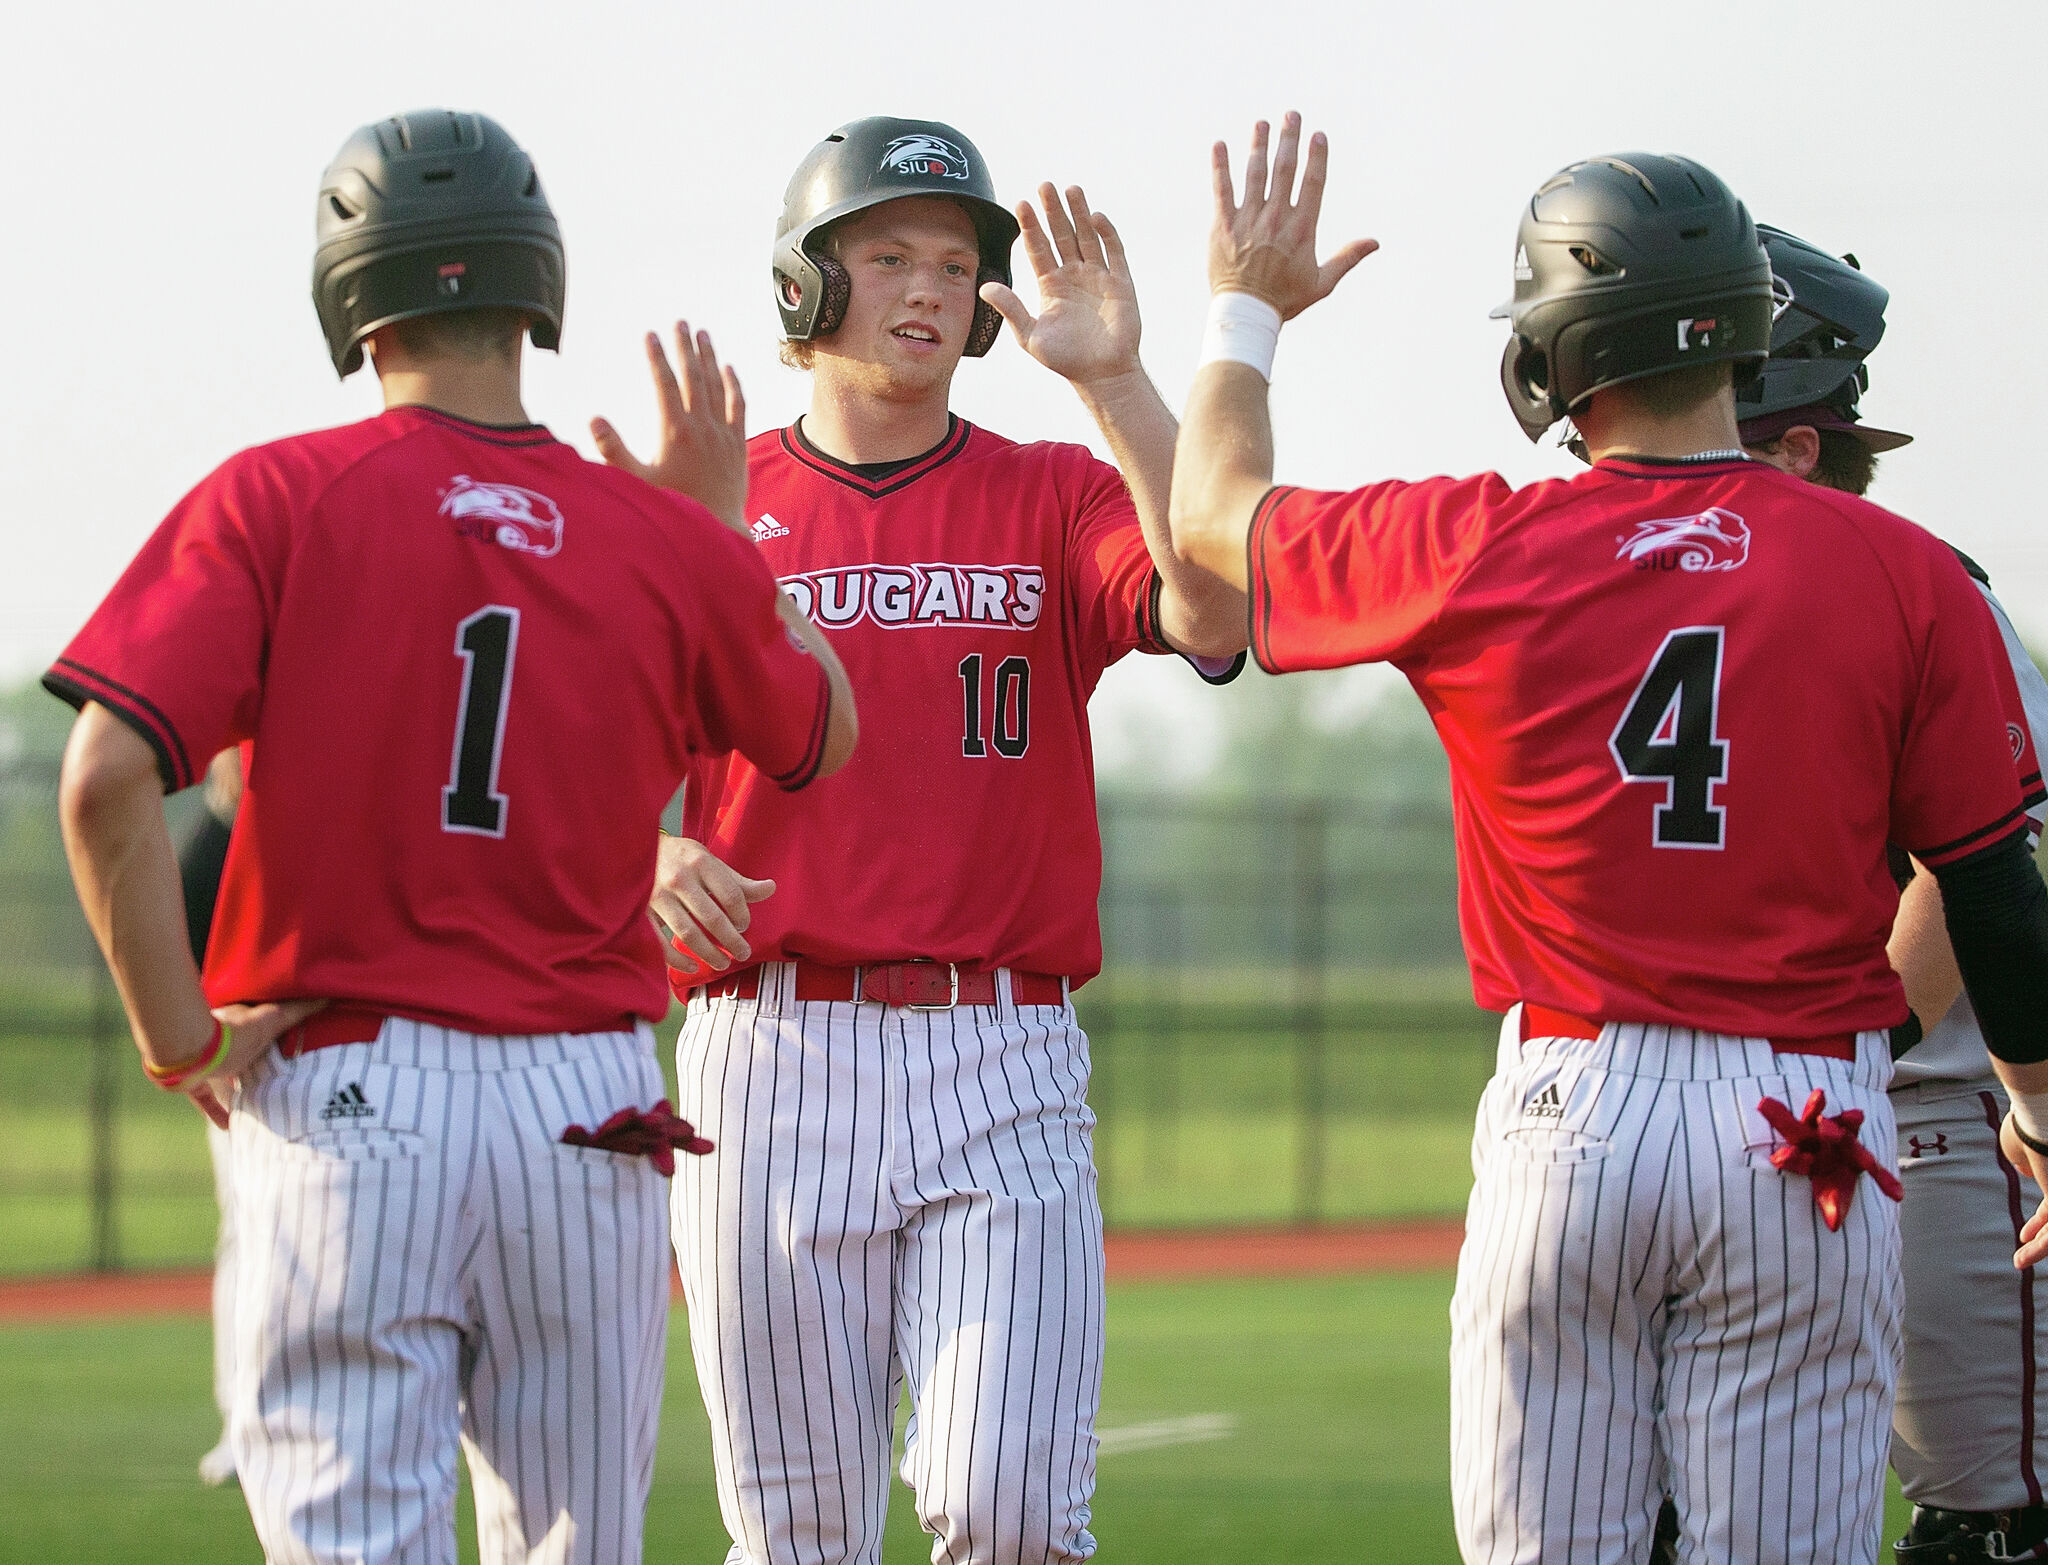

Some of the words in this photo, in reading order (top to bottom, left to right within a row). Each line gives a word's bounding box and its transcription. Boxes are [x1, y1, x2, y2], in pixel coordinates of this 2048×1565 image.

[750, 527, 790, 542] didas
[778, 563, 1045, 630] OUGARS
[441, 604, 521, 839] 1
[958, 653, 1031, 759] 10
[1607, 625, 1731, 851] 4
